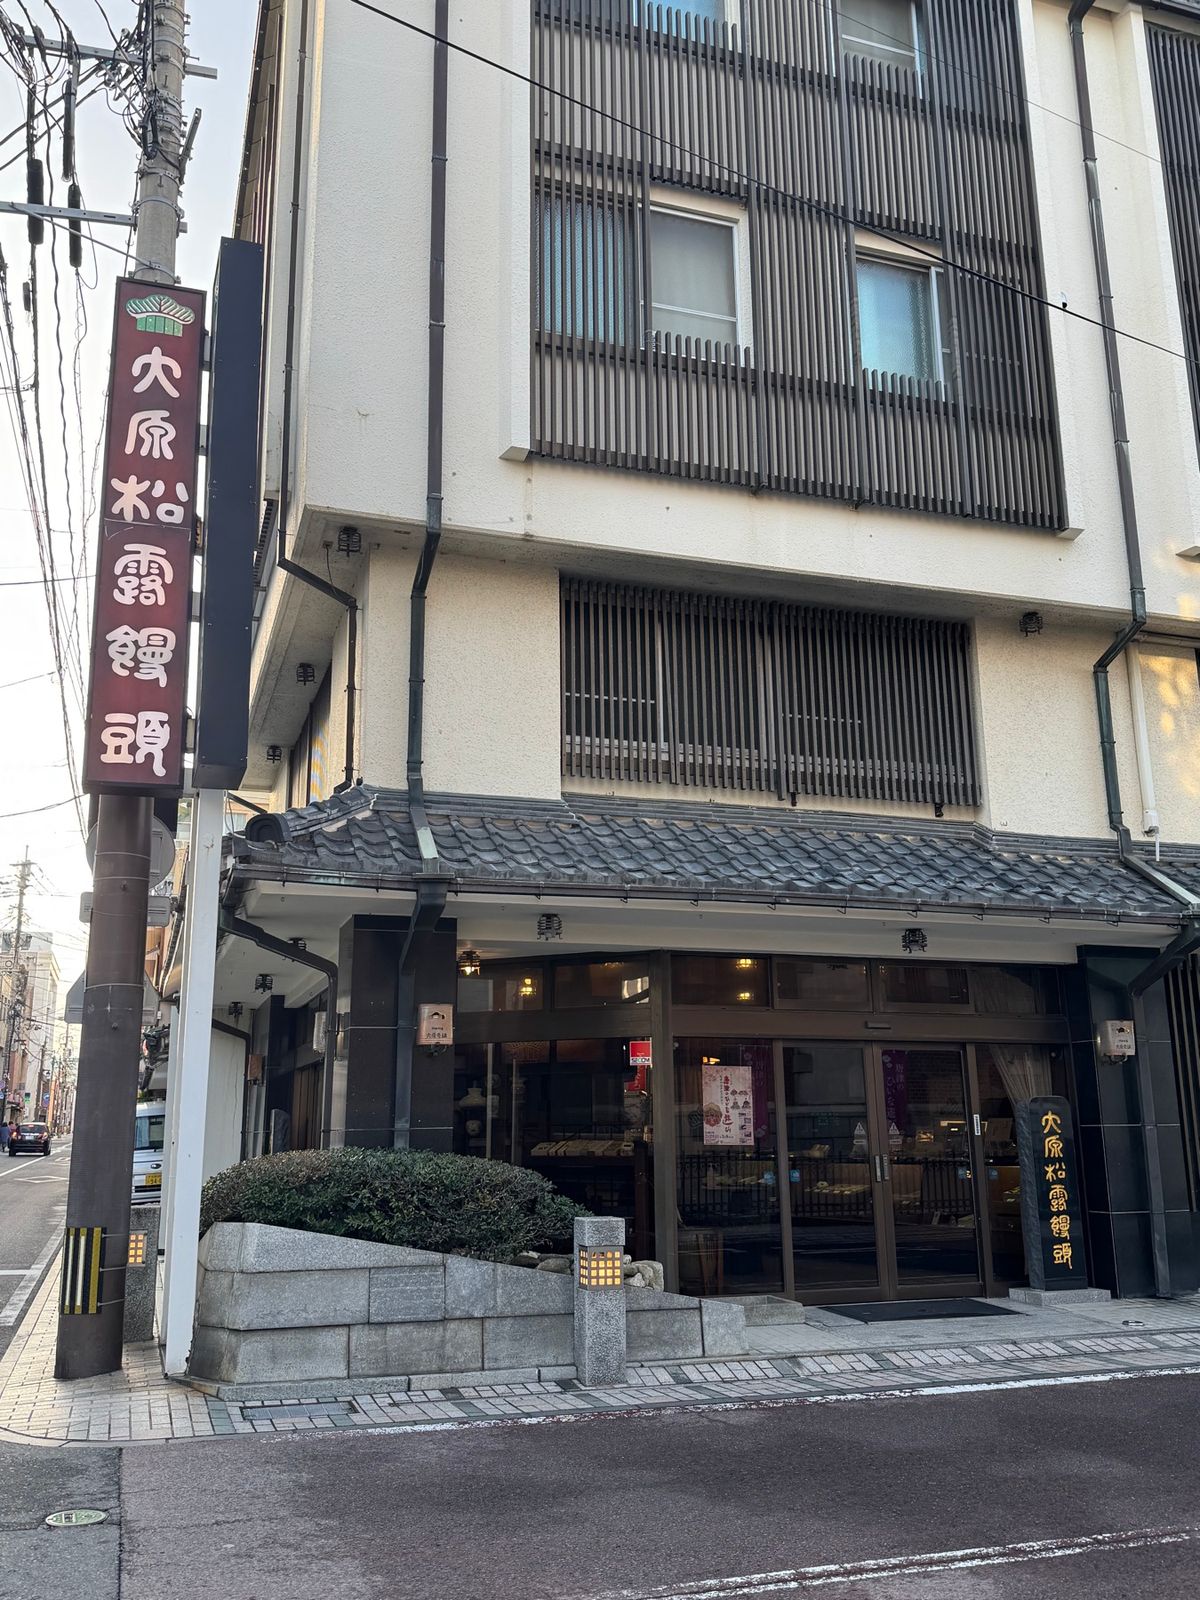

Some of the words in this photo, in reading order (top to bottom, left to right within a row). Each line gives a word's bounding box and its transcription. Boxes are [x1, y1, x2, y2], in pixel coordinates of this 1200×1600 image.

[99, 346, 189, 777] 大原松露饅頭
[1041, 1110, 1072, 1269] 大原松露饅頭
